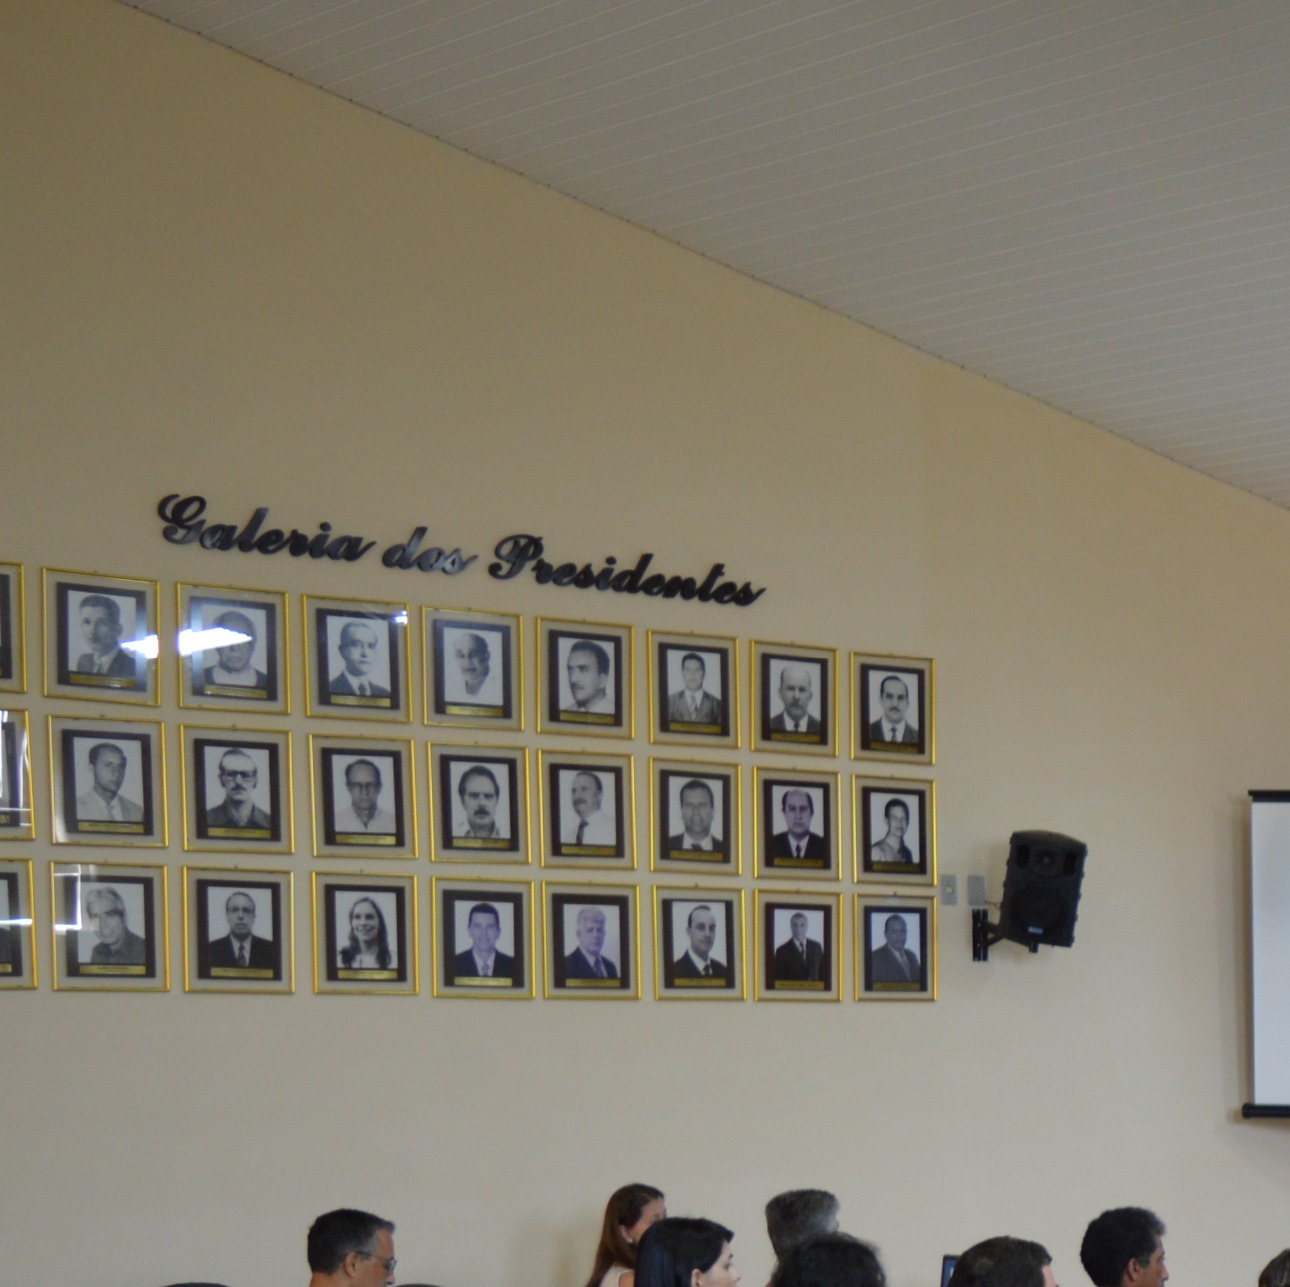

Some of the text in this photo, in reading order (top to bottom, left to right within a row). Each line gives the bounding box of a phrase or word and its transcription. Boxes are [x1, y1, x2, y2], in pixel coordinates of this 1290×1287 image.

[157, 494, 766, 607] Galeria dos Presidentes
